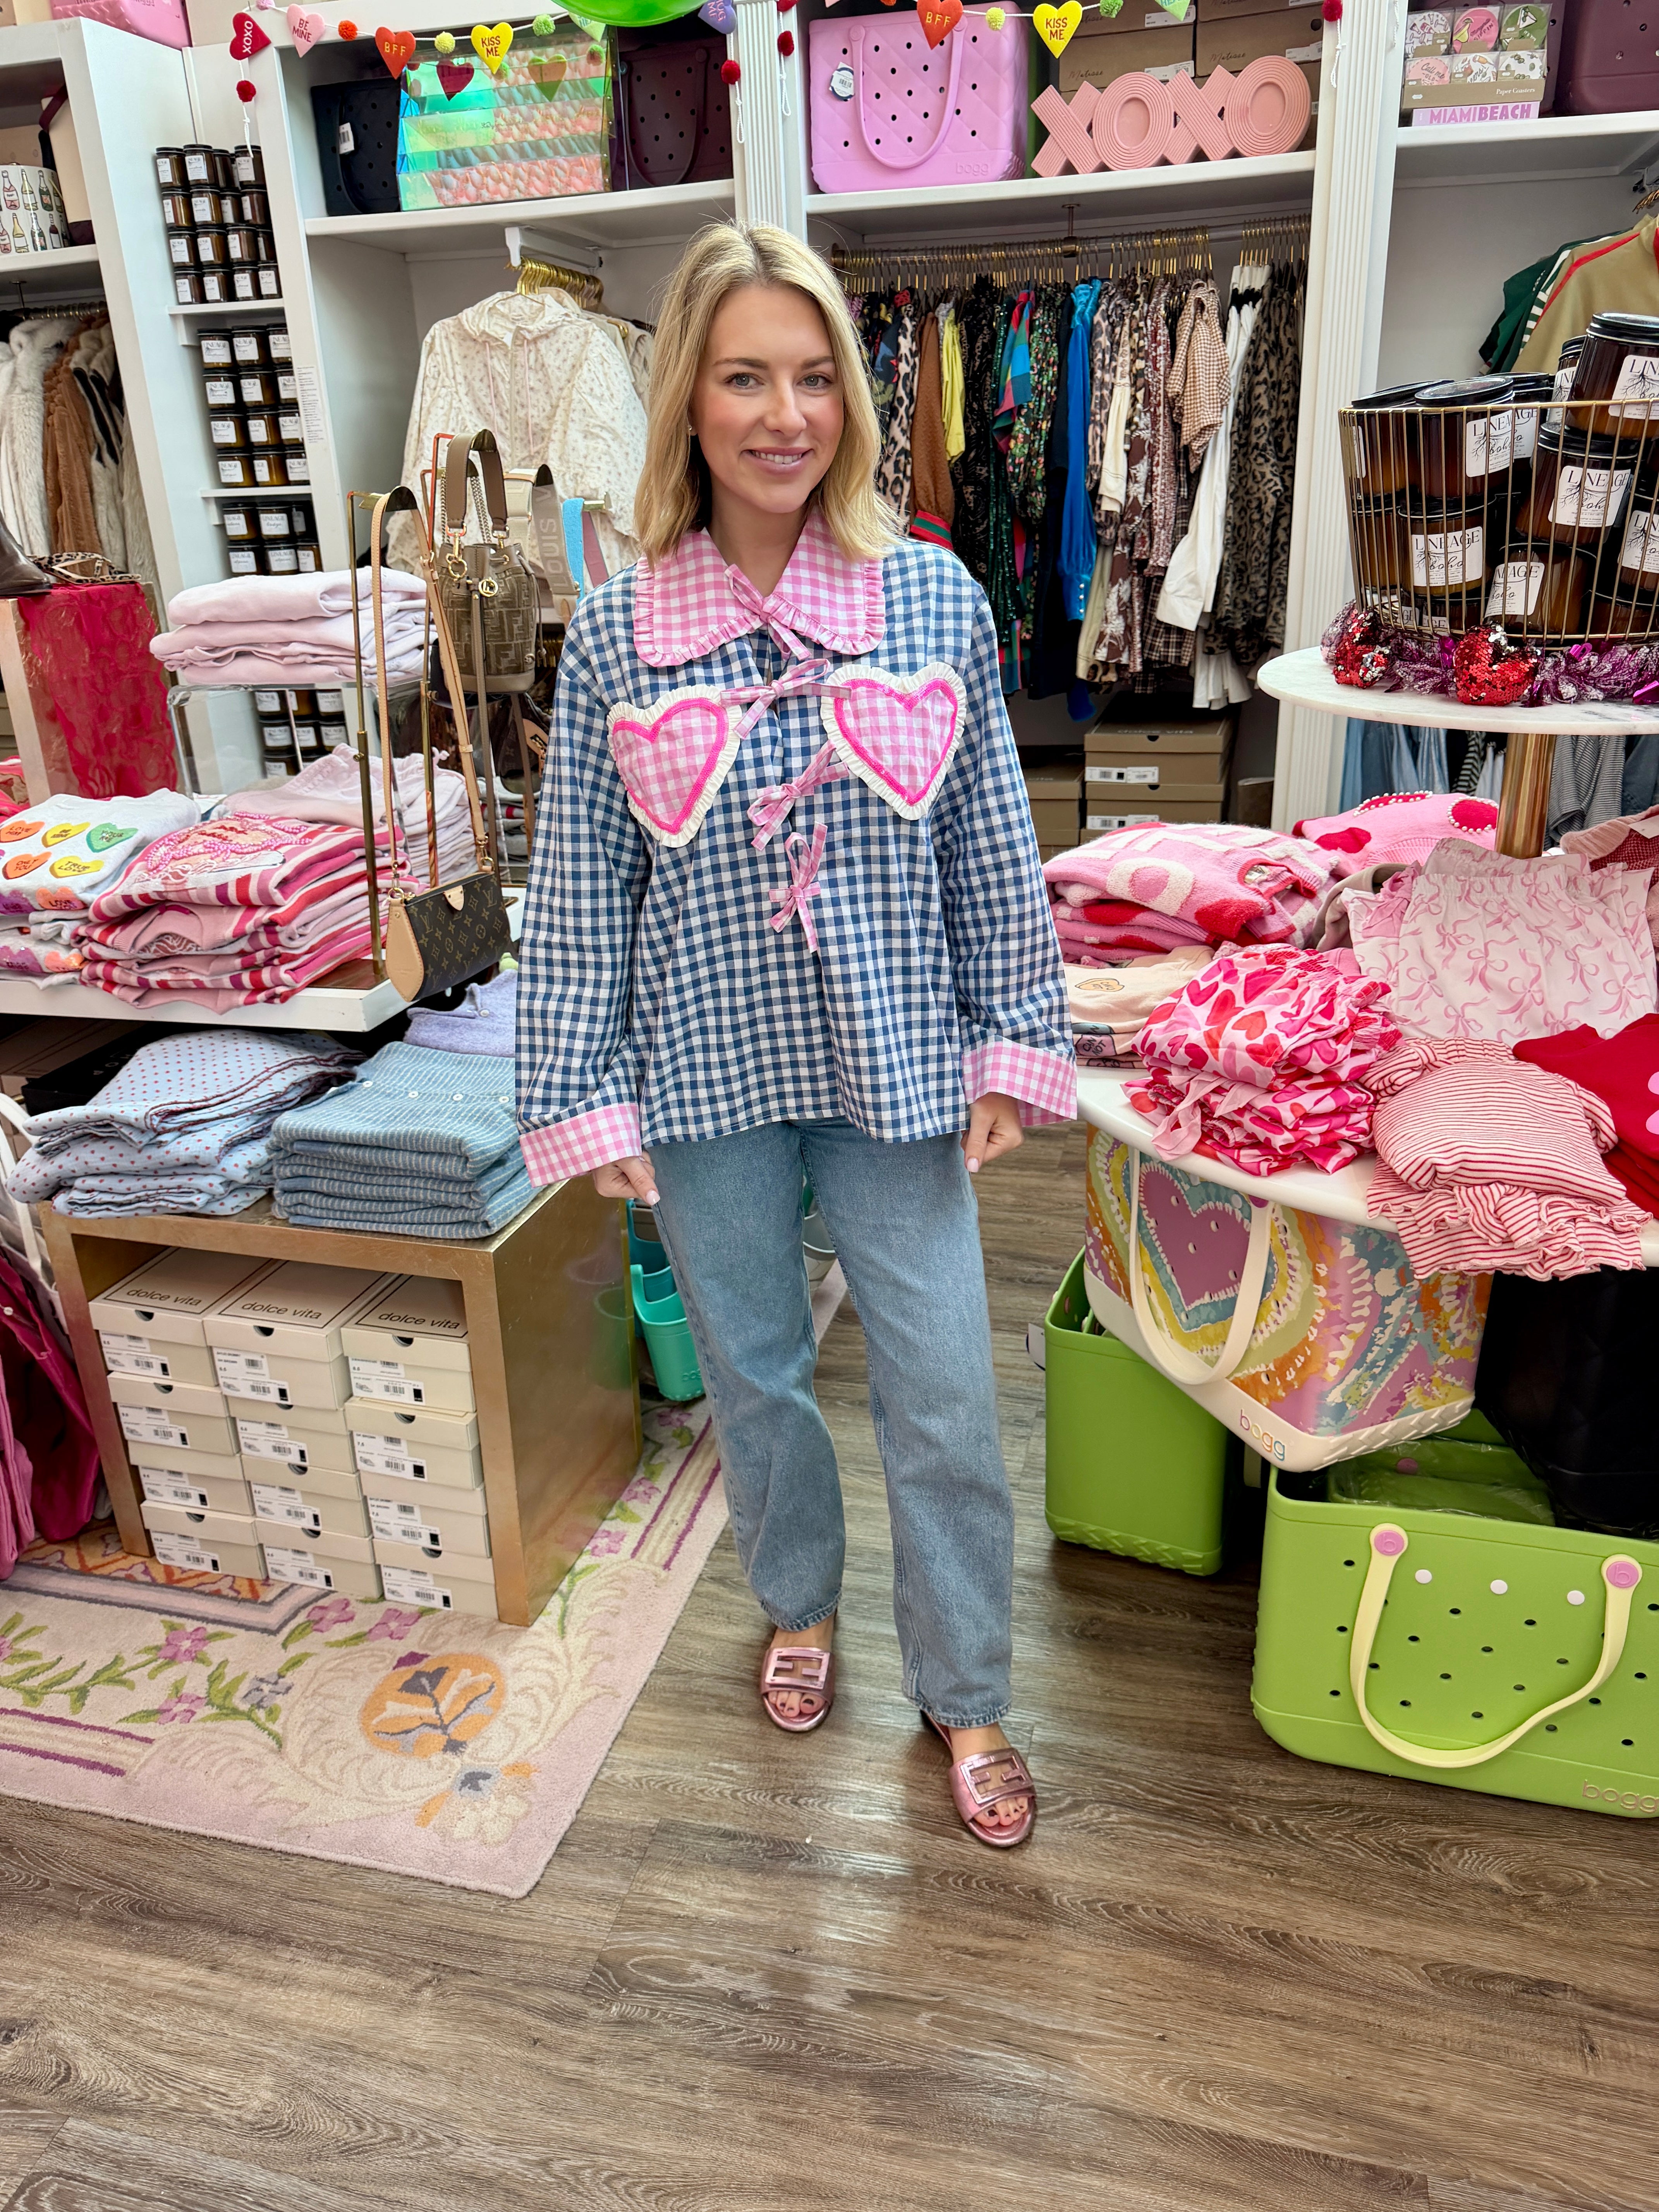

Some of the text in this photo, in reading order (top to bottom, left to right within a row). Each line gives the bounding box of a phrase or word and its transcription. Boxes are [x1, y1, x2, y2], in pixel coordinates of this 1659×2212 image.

[299, 18, 309, 31] BE
[926, 11, 951, 27] BFF
[1046, 17, 1068, 29] KISS
[242, 21, 254, 54] XOXO
[292, 26, 312, 43] MINE
[481, 35, 501, 48] KISS
[1049, 29, 1064, 41] ME
[385, 41, 407, 56] BFF
[486, 46, 500, 57] ME
[1421, 63, 1434, 74] Call
[1031, 55, 1312, 177] XOXO
[956, 162, 989, 176] bogg
[1474, 414, 1510, 436] LINEA
[1489, 436, 1511, 455] boh
[1568, 470, 1629, 487] LNEGE
[1415, 530, 1480, 550] LNEAGE
[539, 518, 569, 587] LOUIS
[1429, 556, 1463, 570] boho
[1495, 565, 1540, 579] NEAGE
[65, 861, 90, 870] TRUE
[1082, 1037, 1097, 1052] CAN
[1092, 1039, 1106, 1056] NOT
[126, 1288, 202, 1307] dolce vita
[241, 1302, 322, 1320] dolce vita
[378, 1312, 460, 1330] dolce vita
[1240, 1409, 1286, 1462] bogg
[1582, 1779, 1659, 1814] bogg
